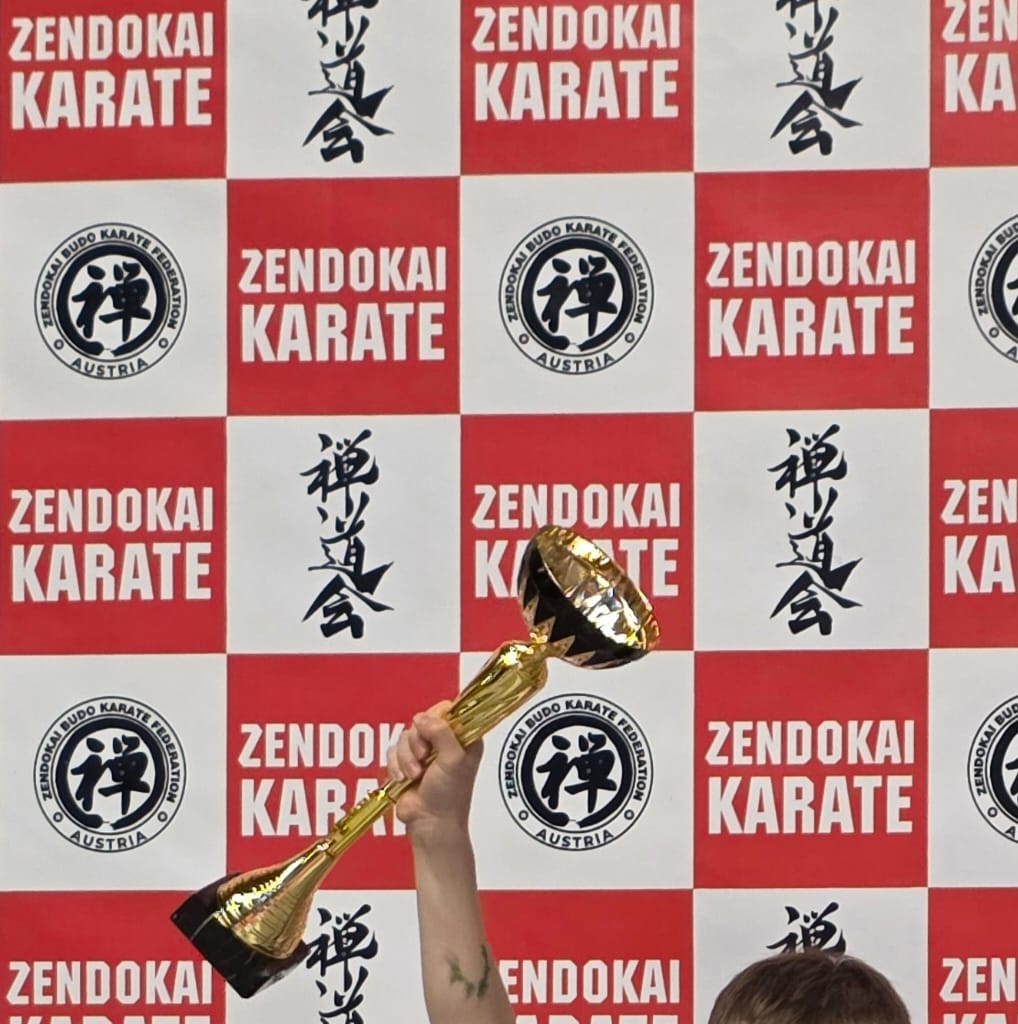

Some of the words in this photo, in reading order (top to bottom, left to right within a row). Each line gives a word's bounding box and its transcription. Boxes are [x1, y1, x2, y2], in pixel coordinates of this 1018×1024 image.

[9, 12, 213, 61] ZENDOKAI
[472, 4, 680, 52] ZENDOKAI
[12, 68, 211, 129] KARATE
[475, 59, 678, 121] KARATE
[40, 259, 62, 328] ZENDOKAI
[61, 233, 96, 258] BUDO
[100, 230, 151, 249] KARATE
[151, 248, 181, 330] FEDERATION
[239, 247, 446, 293] ZENDOKAI
[706, 240, 915, 287] ZENDOKAI
[242, 302, 444, 362] KARATE
[709, 296, 914, 357] KARATE
[71, 358, 148, 377] AUSTRIA
[9, 487, 213, 533] ZENDOKAI
[472, 483, 680, 533] ZENDOKAI
[12, 542, 211, 602] KARATE
[705, 720, 914, 765] ZENDOKAI
[973, 726, 996, 796] ZENDOKAI
[709, 776, 912, 834] KARATE
[6, 960, 212, 1005] ZENDOKAI
